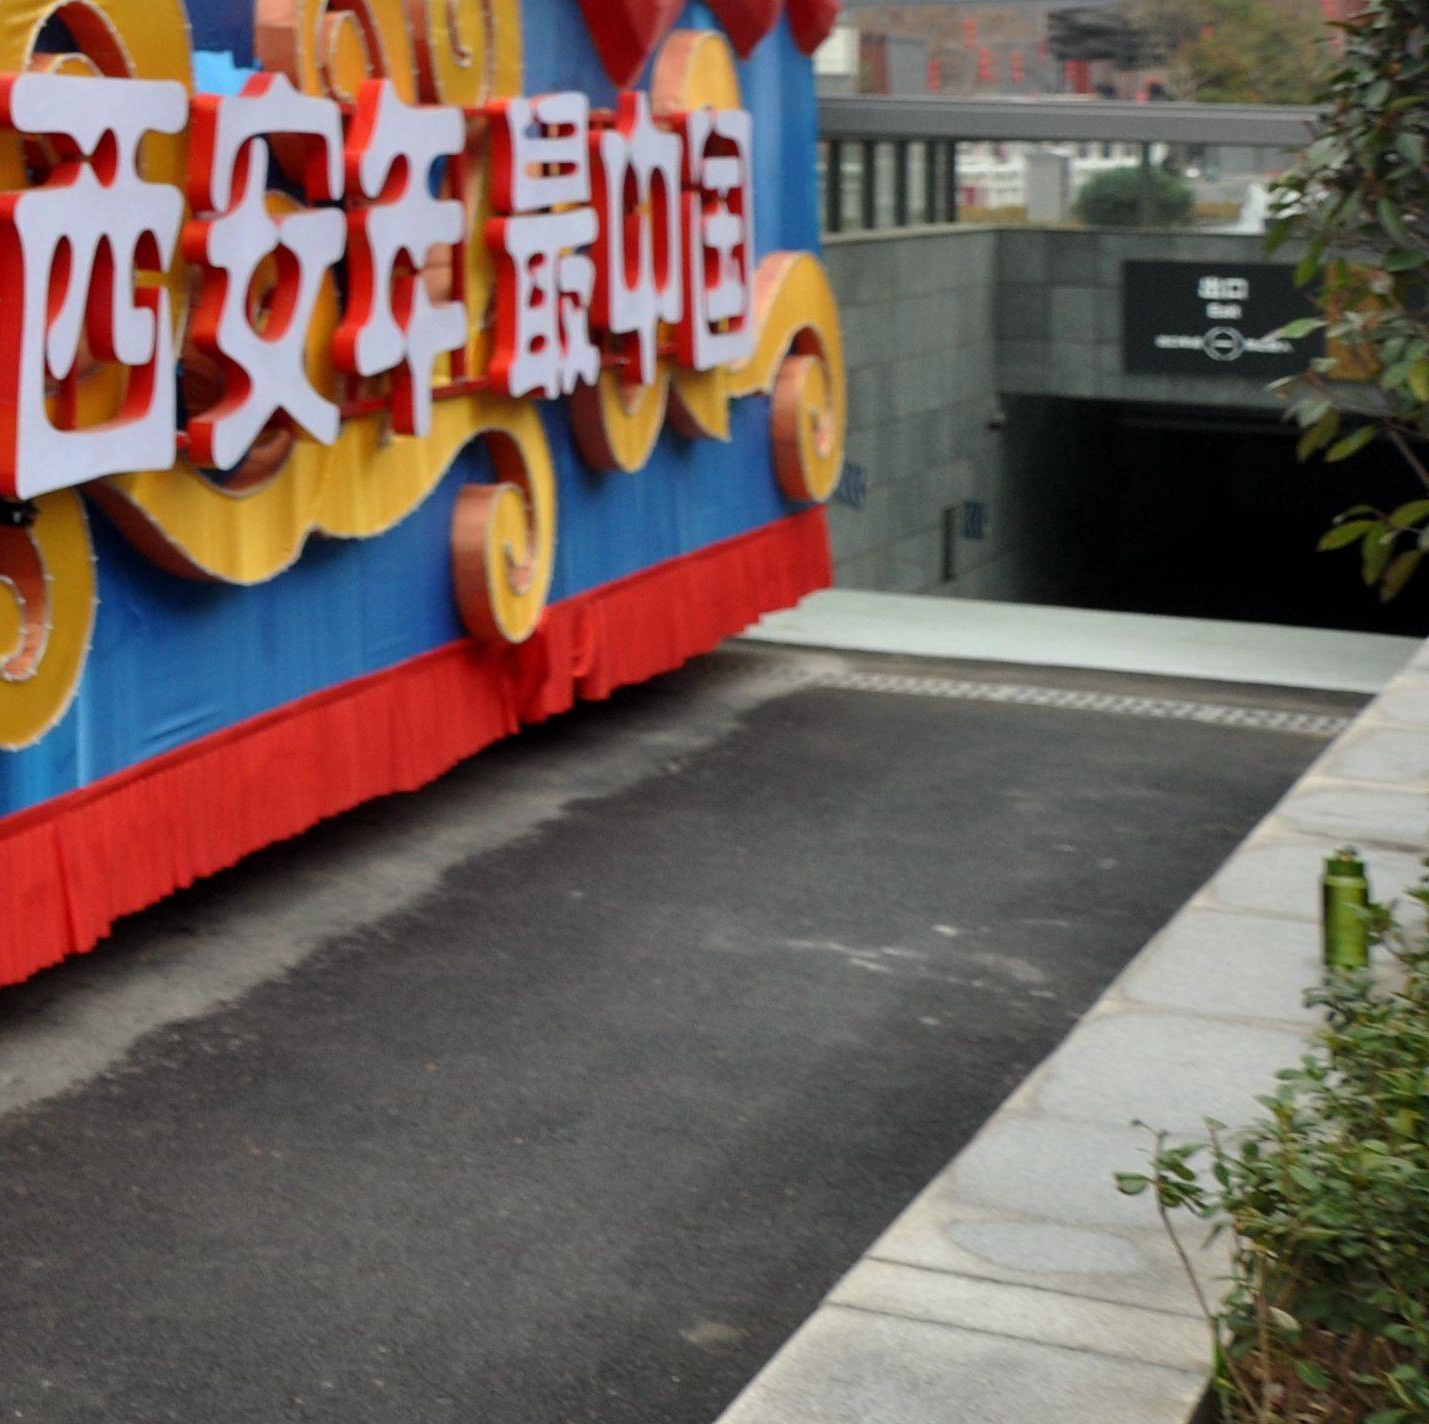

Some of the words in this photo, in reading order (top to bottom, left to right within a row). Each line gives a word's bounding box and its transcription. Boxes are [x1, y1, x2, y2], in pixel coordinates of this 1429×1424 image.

[11, 72, 467, 500] 西安年
[502, 90, 755, 400] 最中国
